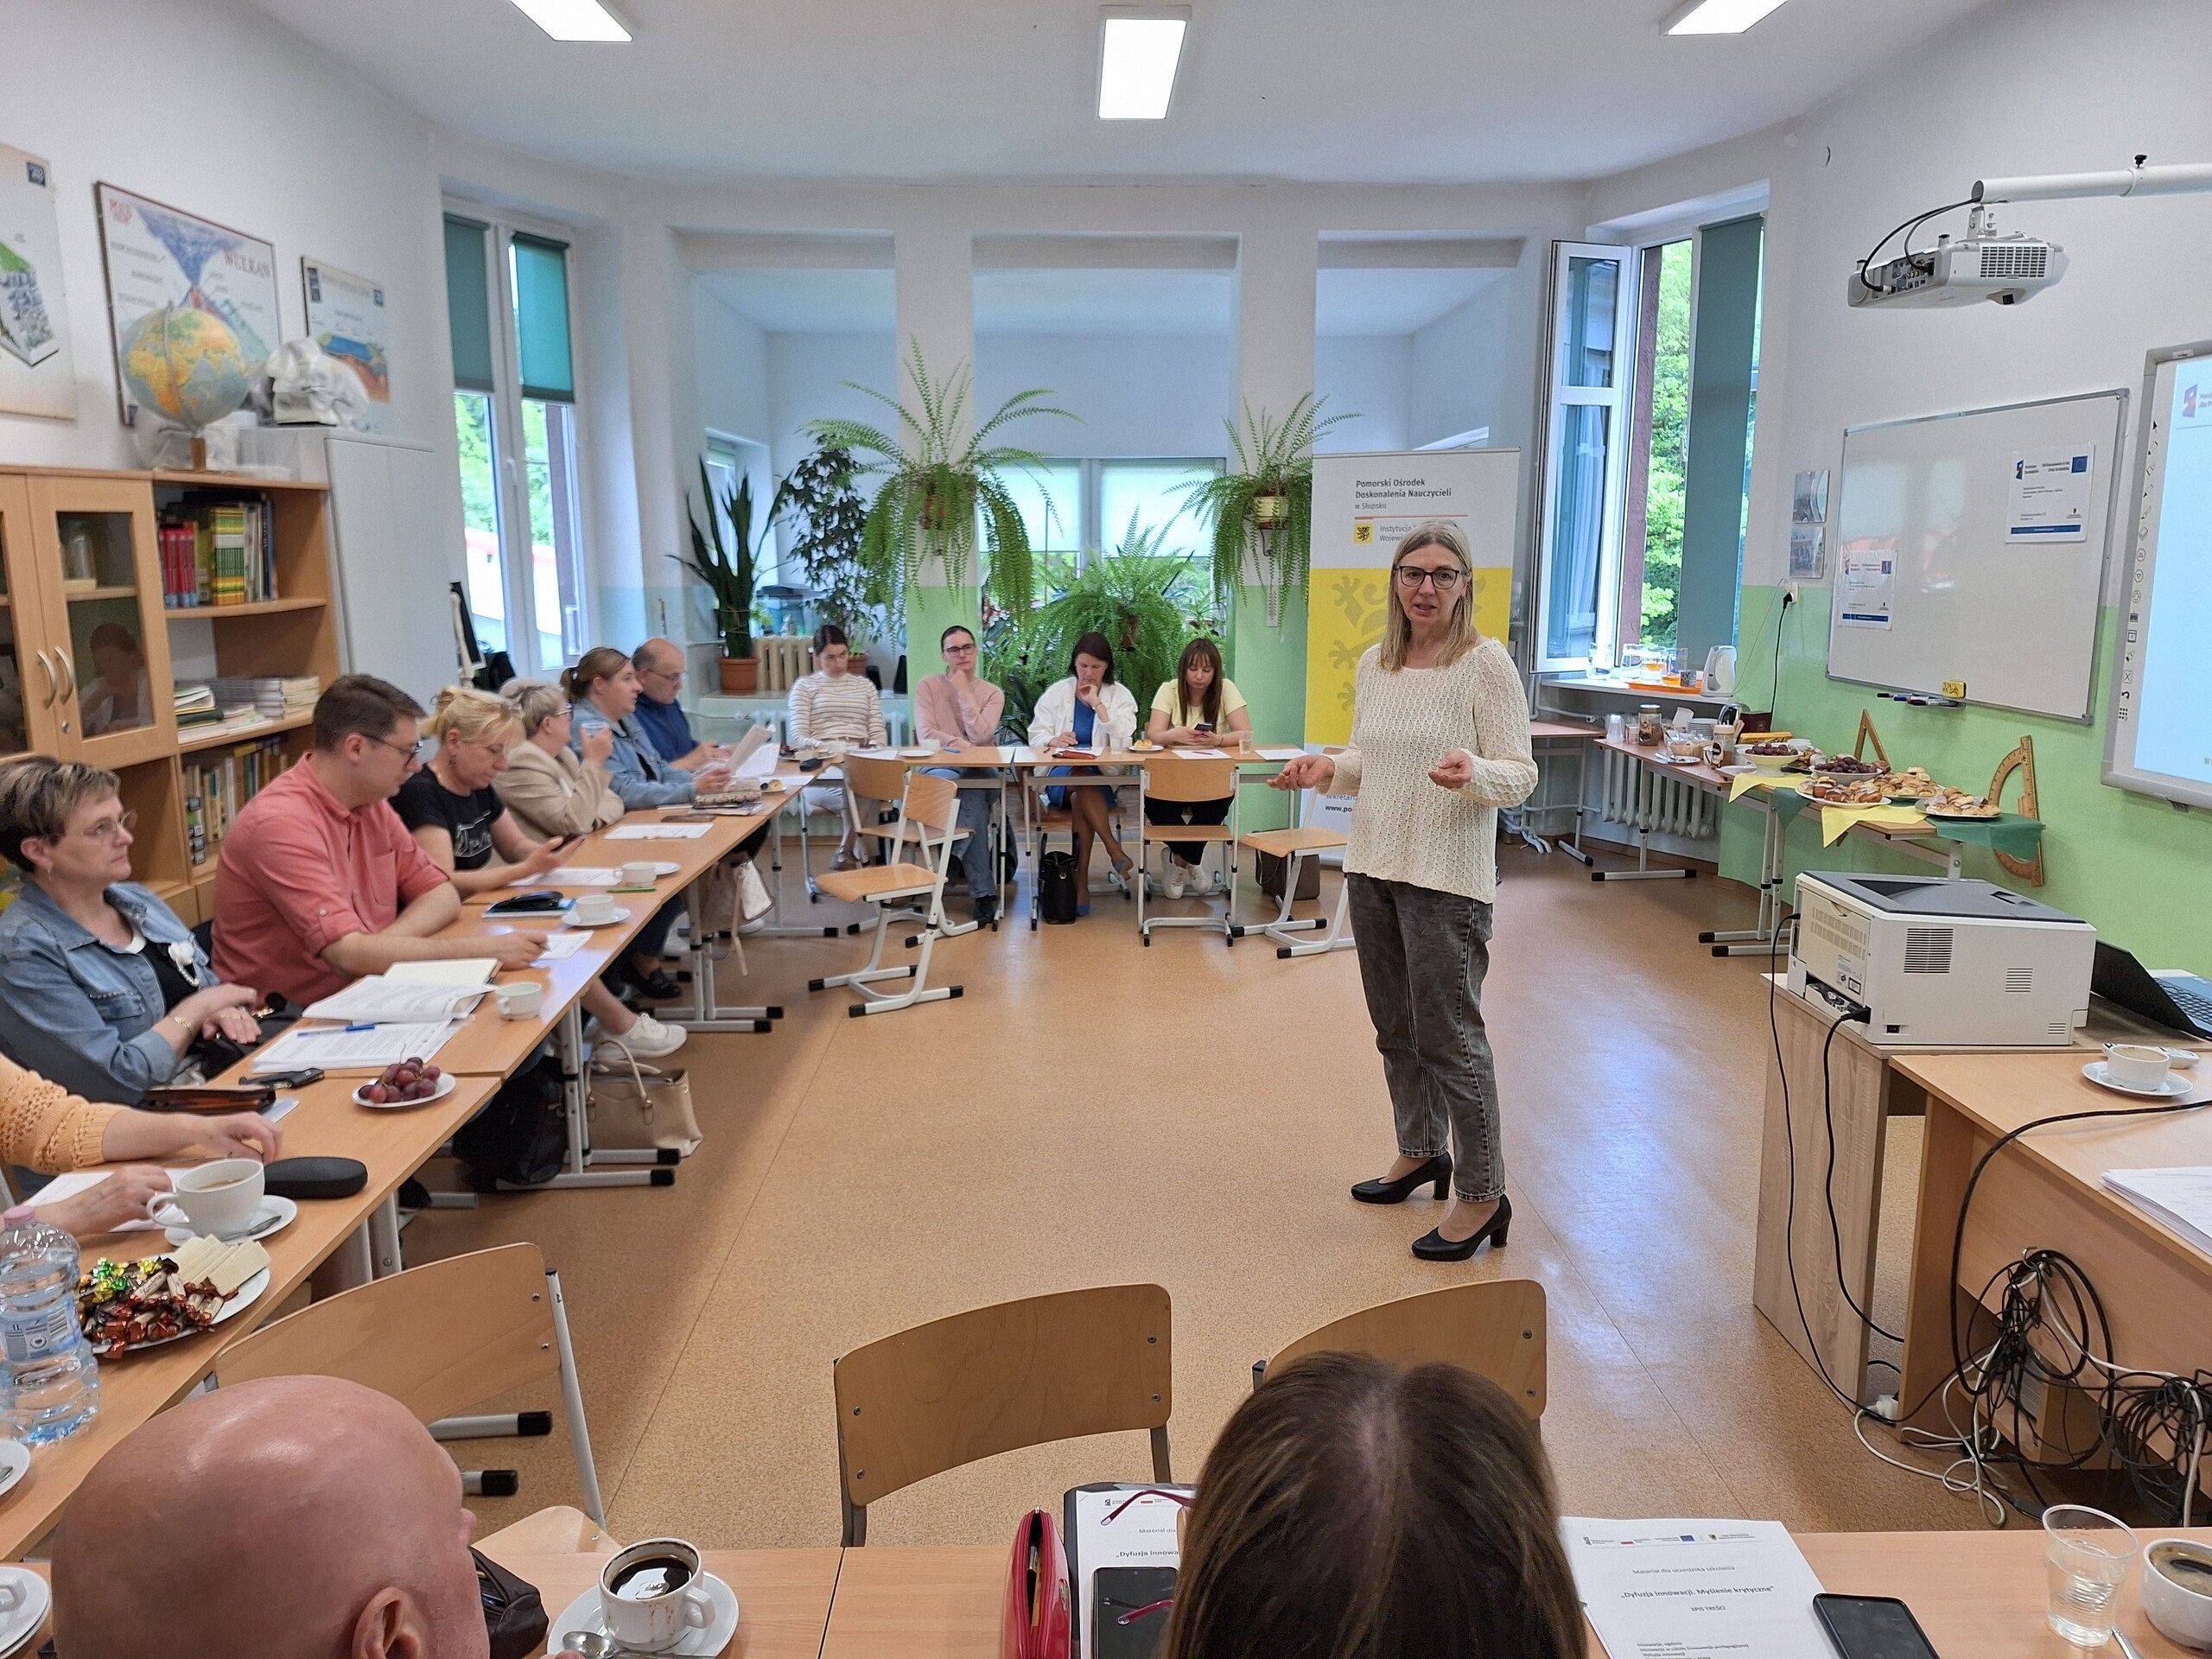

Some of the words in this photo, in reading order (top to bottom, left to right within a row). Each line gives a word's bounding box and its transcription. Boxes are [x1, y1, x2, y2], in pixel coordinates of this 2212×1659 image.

[1356, 479, 1391, 487] Pomorski
[1393, 478, 1426, 487] Ośrodek
[1355, 490, 1406, 499] Doskonalenia
[1408, 488, 1452, 499] Nauczycieli
